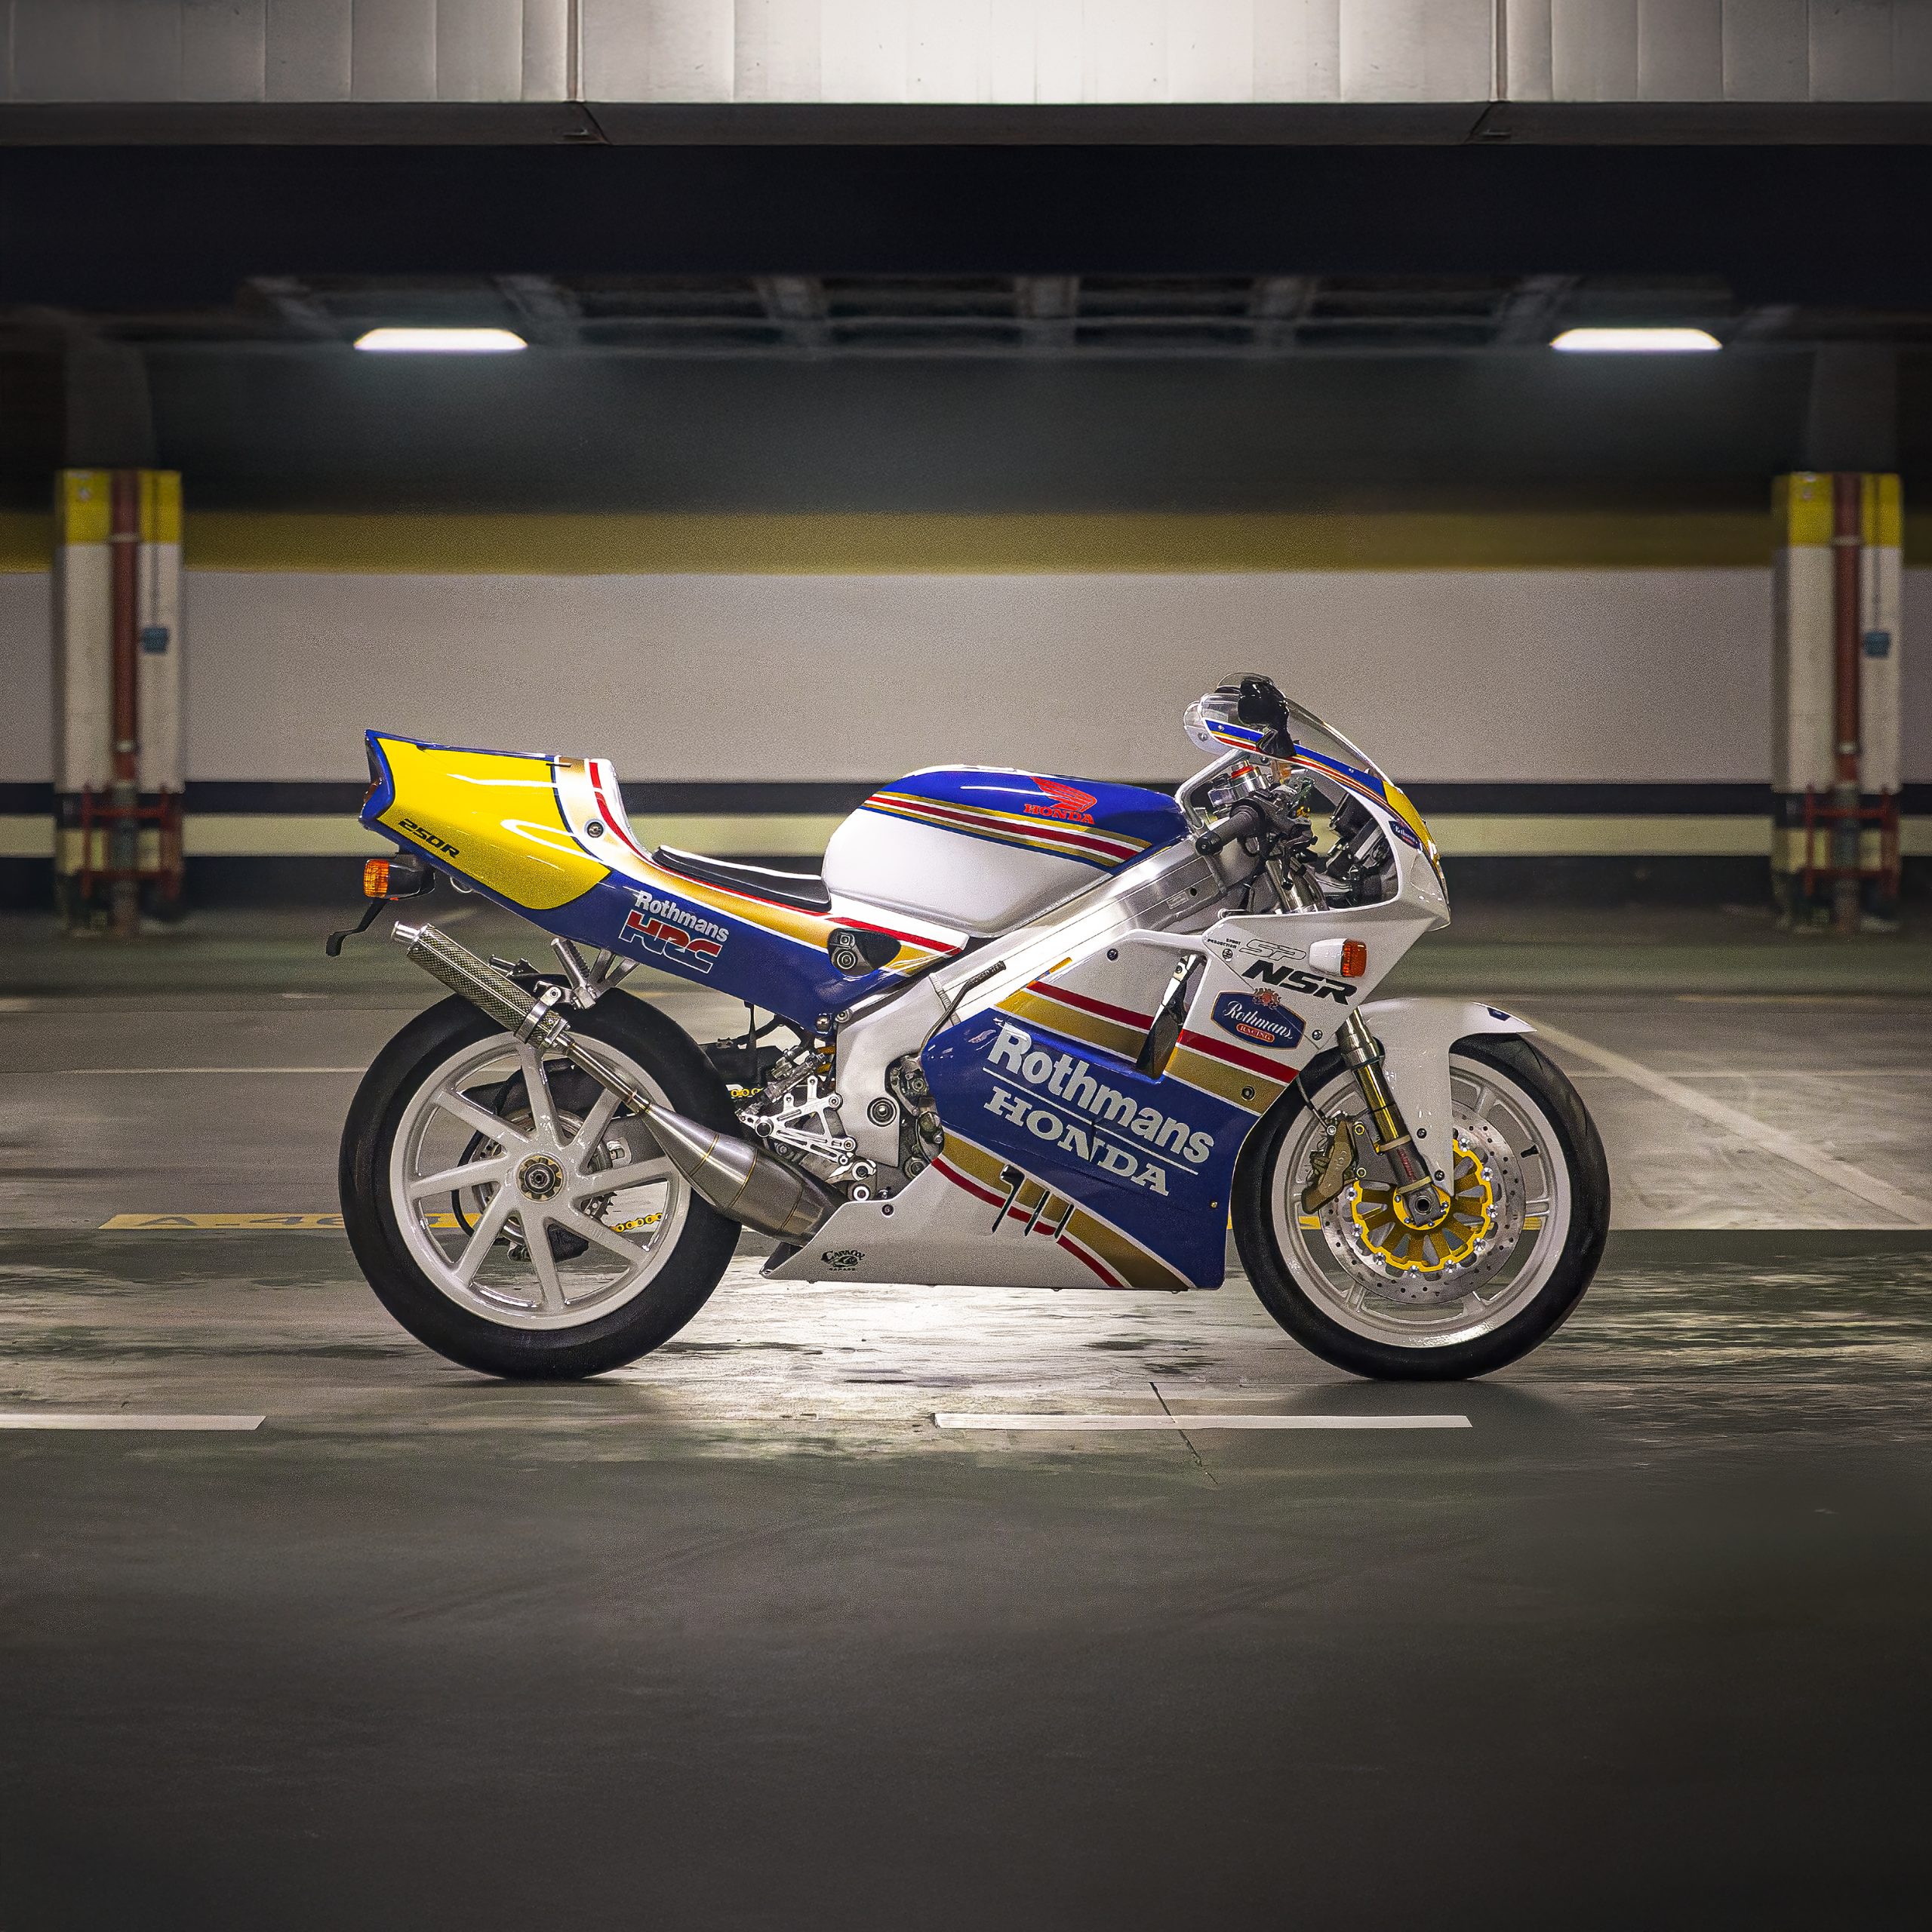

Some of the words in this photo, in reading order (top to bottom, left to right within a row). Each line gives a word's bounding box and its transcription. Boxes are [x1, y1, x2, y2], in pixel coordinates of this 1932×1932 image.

[1023, 803, 1095, 825] HONDA
[398, 818, 460, 859] 250R
[633, 890, 730, 943] Rothmans
[618, 909, 723, 974] HRC
[1208, 938, 1237, 949] PRODUCTION
[1238, 938, 1307, 961] SP
[1241, 959, 1358, 1005] NSR
[1223, 1001, 1293, 1039] Rothmans
[1239, 1025, 1272, 1041] RACING
[986, 1021, 1214, 1164] Rothmans
[983, 1085, 1170, 1196] HONDA
